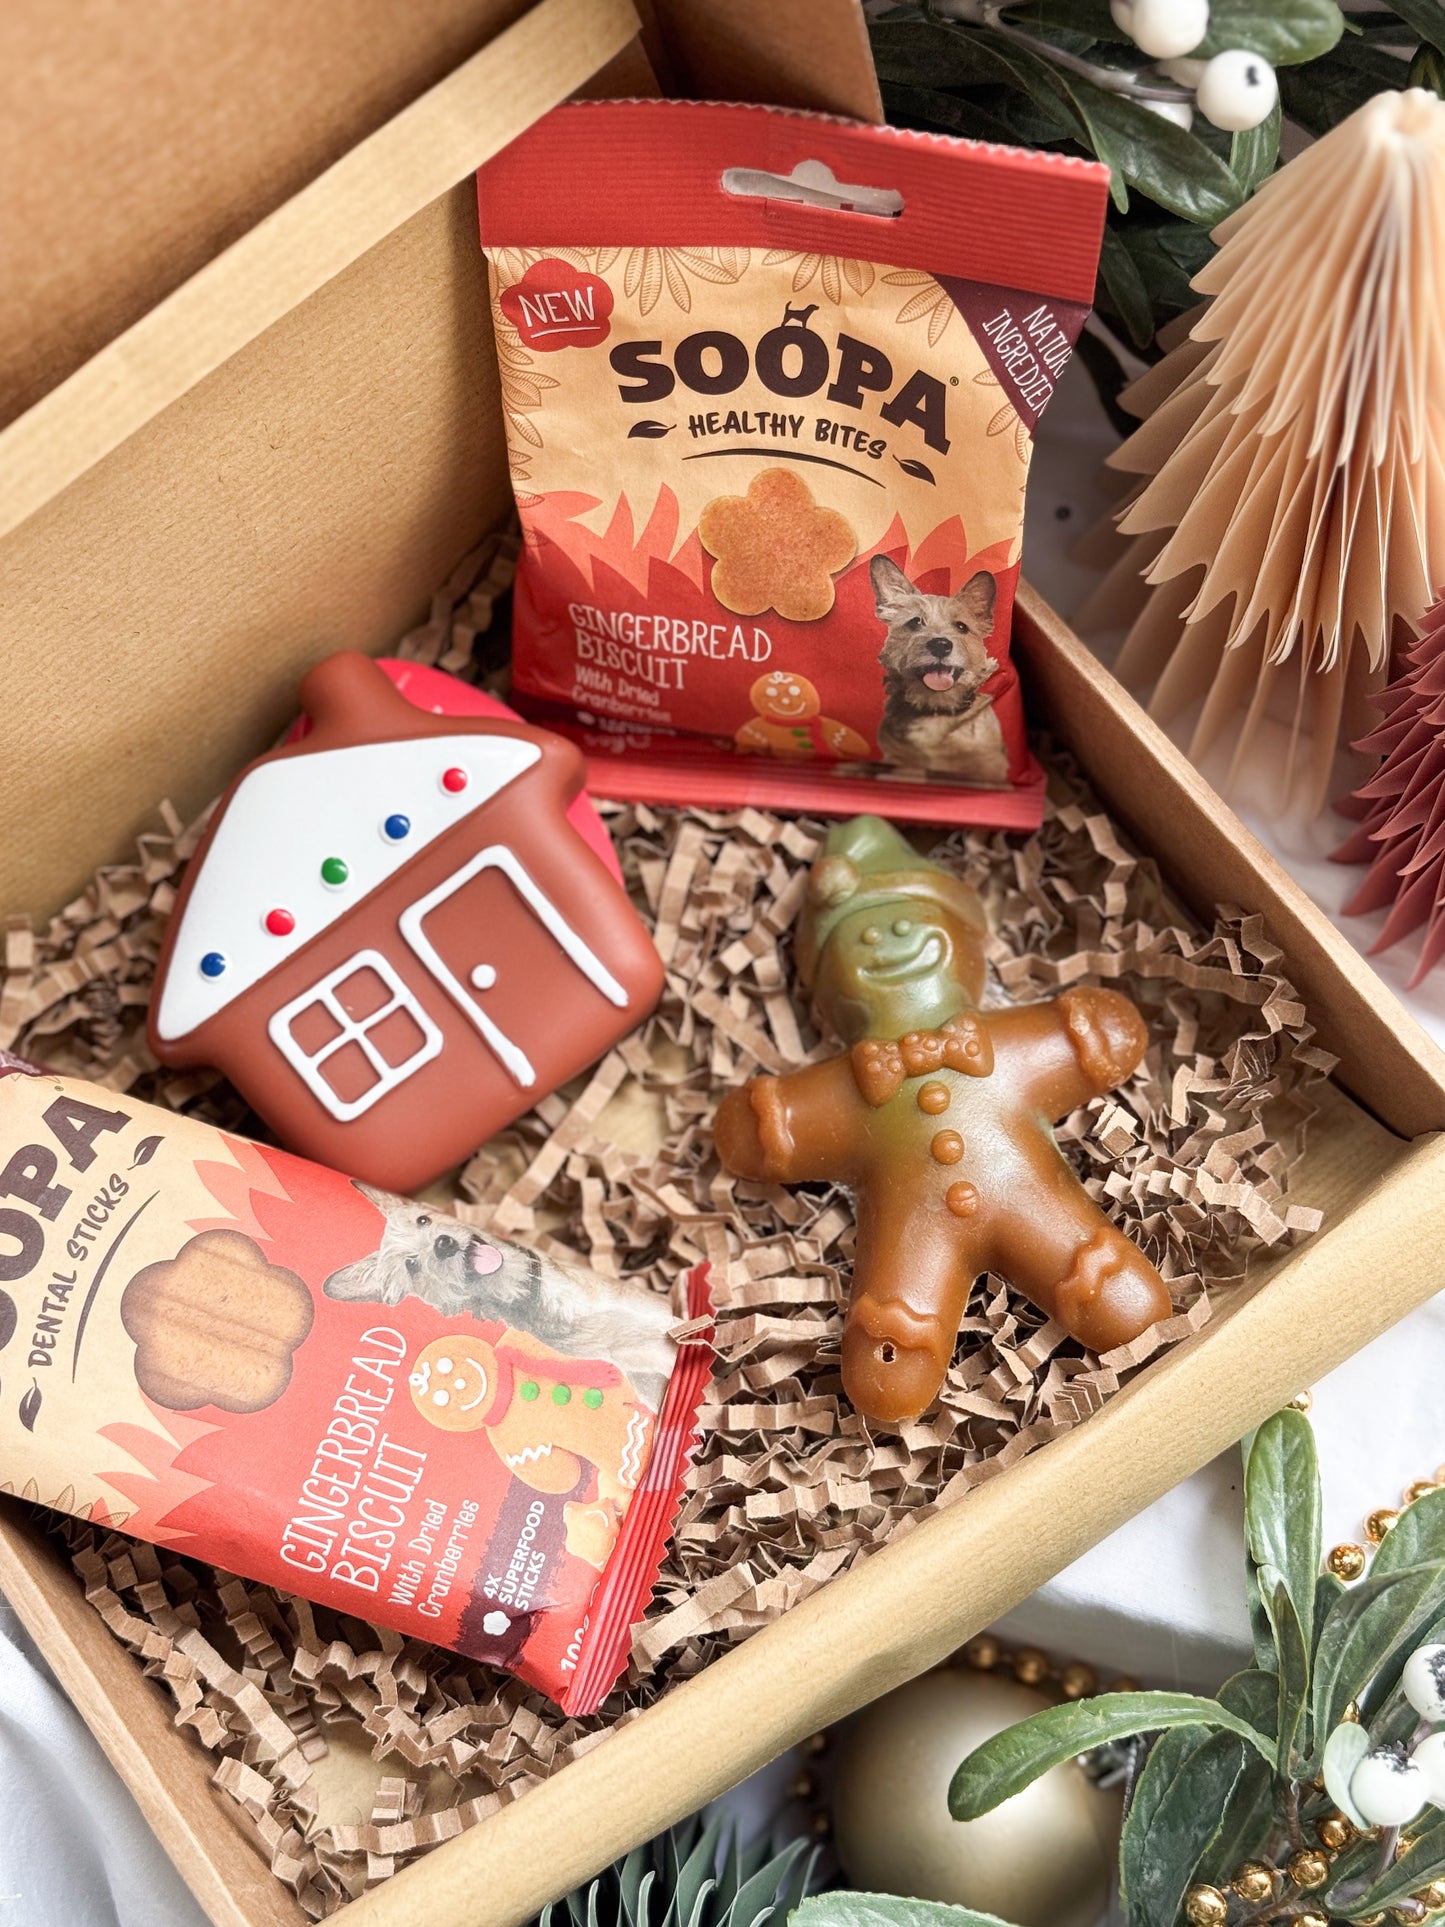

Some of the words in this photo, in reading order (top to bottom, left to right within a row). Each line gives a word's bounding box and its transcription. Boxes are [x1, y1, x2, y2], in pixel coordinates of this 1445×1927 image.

[518, 286, 599, 325] NEW
[1022, 304, 1072, 379] NATUR
[609, 326, 950, 455] SOOPA
[687, 410, 804, 440] HEALTHY
[815, 421, 887, 460] BITES
[568, 603, 772, 663] GINGERBREAD
[576, 629, 688, 690] BISCUIT
[0, 1095, 133, 1352] OPA
[28, 1270, 77, 1367] DENTAL
[66, 1173, 130, 1262] STICKS
[280, 1326, 408, 1575] GINGERBREAD
[330, 1433, 428, 1593] BISCUIT
[388, 1548, 426, 1607] With
[416, 1498, 448, 1554] Dried
[418, 1500, 480, 1618] Cranberries
[498, 1500, 545, 1605] SUPERFOOD
[483, 1573, 502, 1599] 4X
[514, 1550, 546, 1611] STICKS
